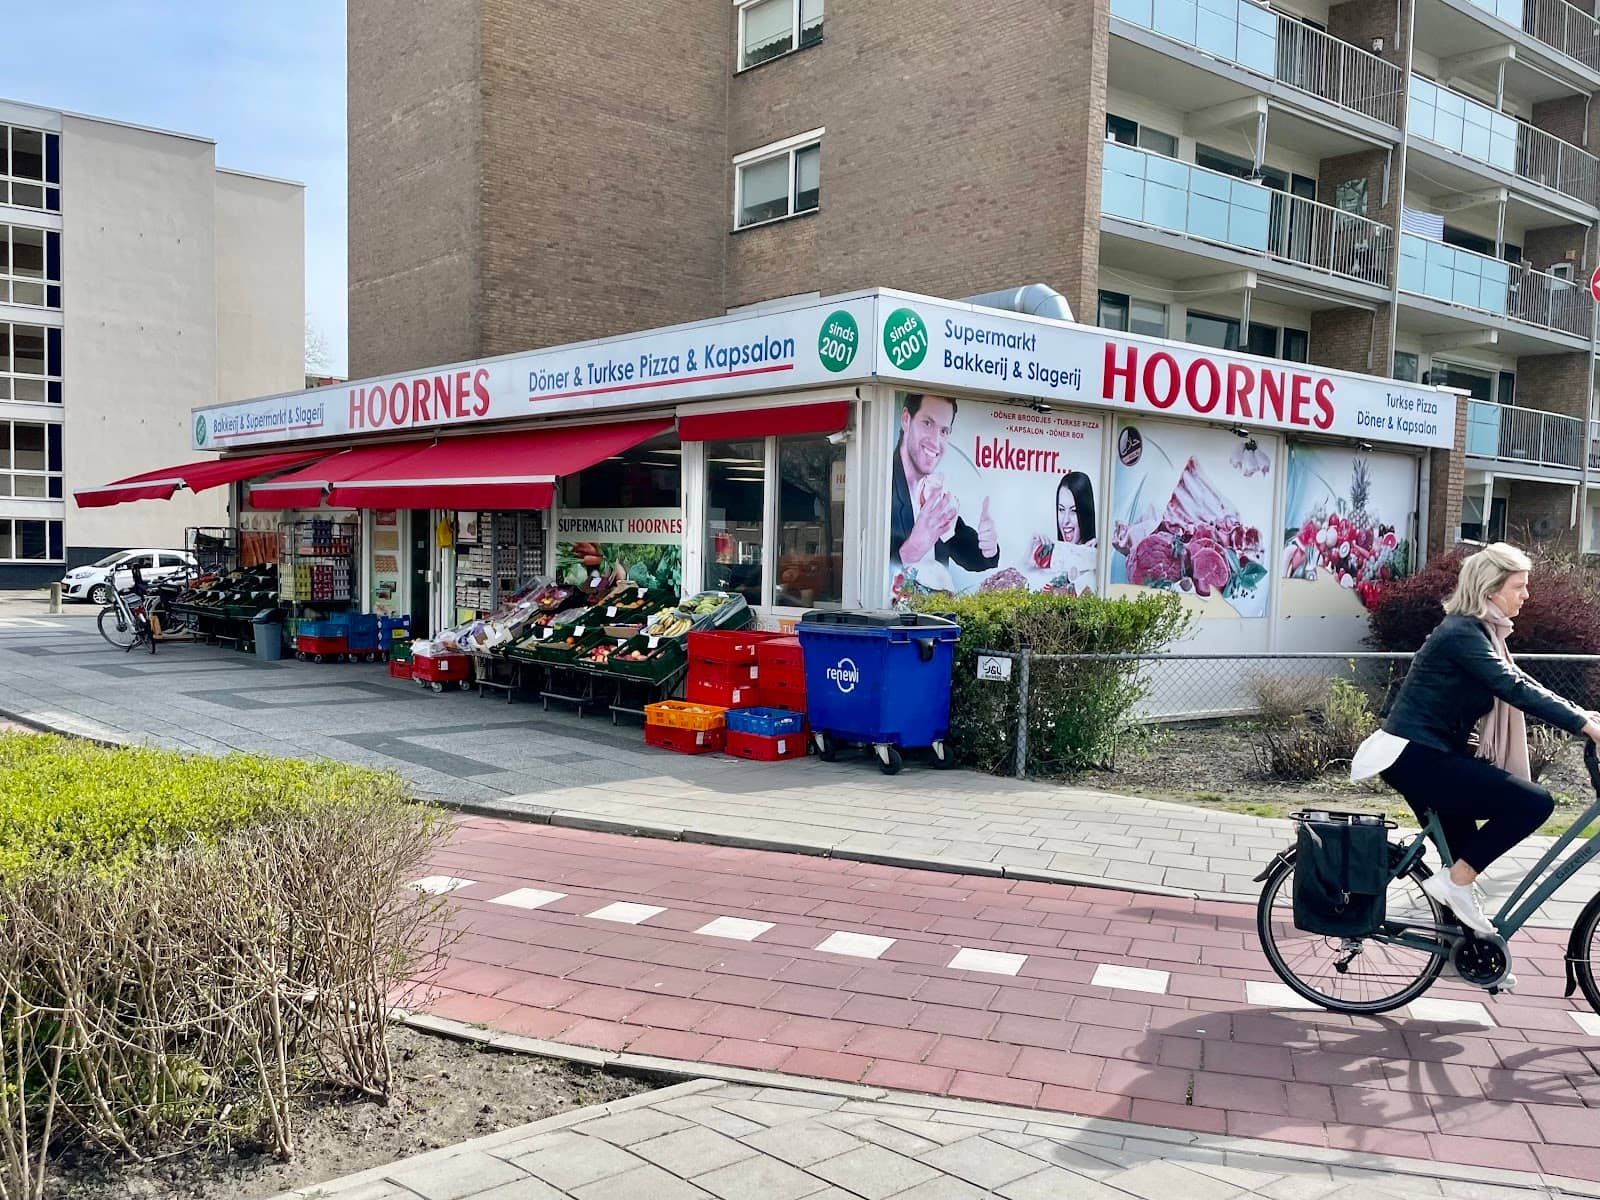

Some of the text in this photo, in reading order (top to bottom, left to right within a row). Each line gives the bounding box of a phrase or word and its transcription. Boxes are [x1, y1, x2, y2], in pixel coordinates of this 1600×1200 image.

[828, 321, 855, 342] sinds
[889, 316, 918, 343] sinds
[944, 319, 1037, 352] Supermarkt
[820, 338, 853, 365] 2001
[892, 329, 928, 367] 2001
[528, 335, 795, 393] Döner & Turkse Pizza & Kapsalon
[943, 349, 1082, 391] Bakkerij & Slagerij
[349, 368, 491, 430] HOORNES
[1102, 342, 1336, 430] HOORNES
[1386, 392, 1438, 415] Turkse Pizza
[213, 415, 239, 434] Bakkerij
[240, 415, 245, 430] &
[246, 408, 287, 432] Supermarkt
[288, 409, 294, 423] &
[294, 402, 324, 428] Slagerij
[1009, 425, 1044, 435] KAPSALON
[1082, 420, 1100, 429] PIZZA
[1357, 410, 1437, 436] Döner & Kapsalon
[558, 518, 682, 534] SUPERMARKT HOORNES
[826, 666, 859, 684] renewi
